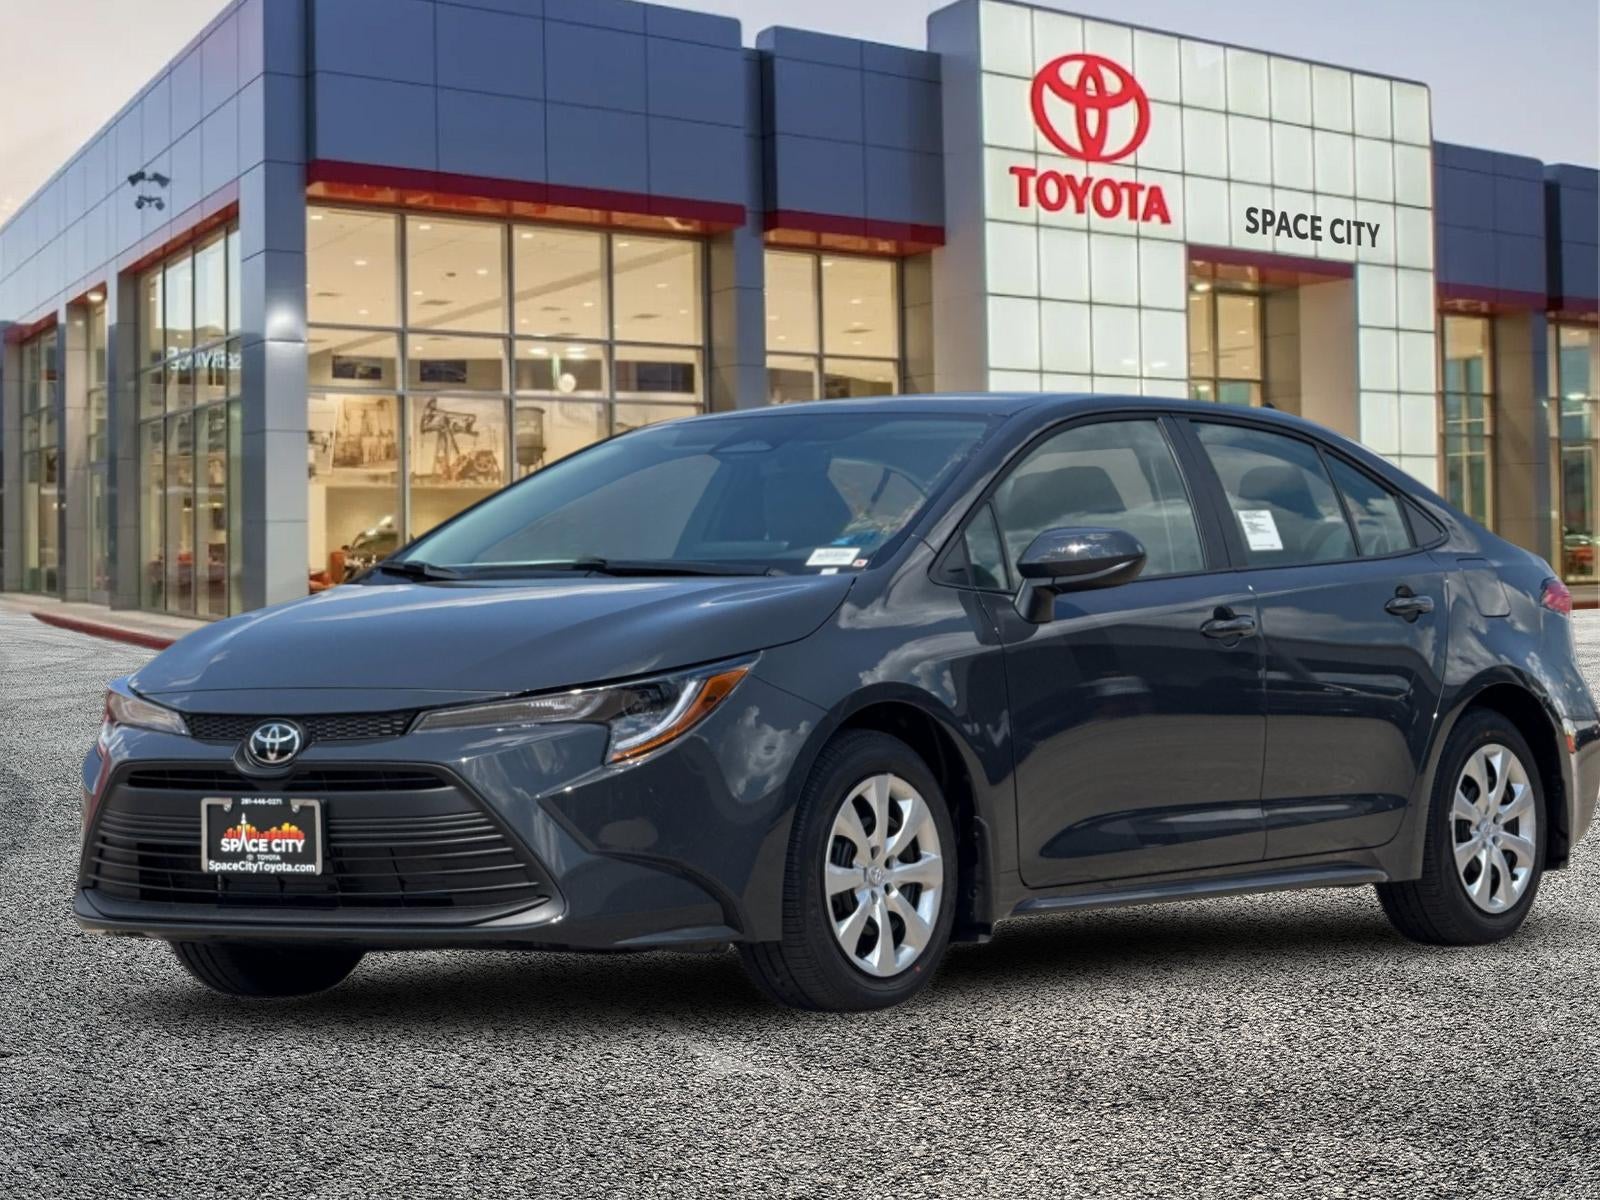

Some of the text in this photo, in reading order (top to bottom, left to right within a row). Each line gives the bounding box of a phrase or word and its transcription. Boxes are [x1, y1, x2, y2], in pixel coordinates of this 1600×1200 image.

[1009, 166, 1171, 225] TOYOTA
[1245, 206, 1381, 248] SPACE CITY
[221, 838, 305, 853] SPACE CITY
[208, 860, 316, 874] SpaceCityToyota.com
